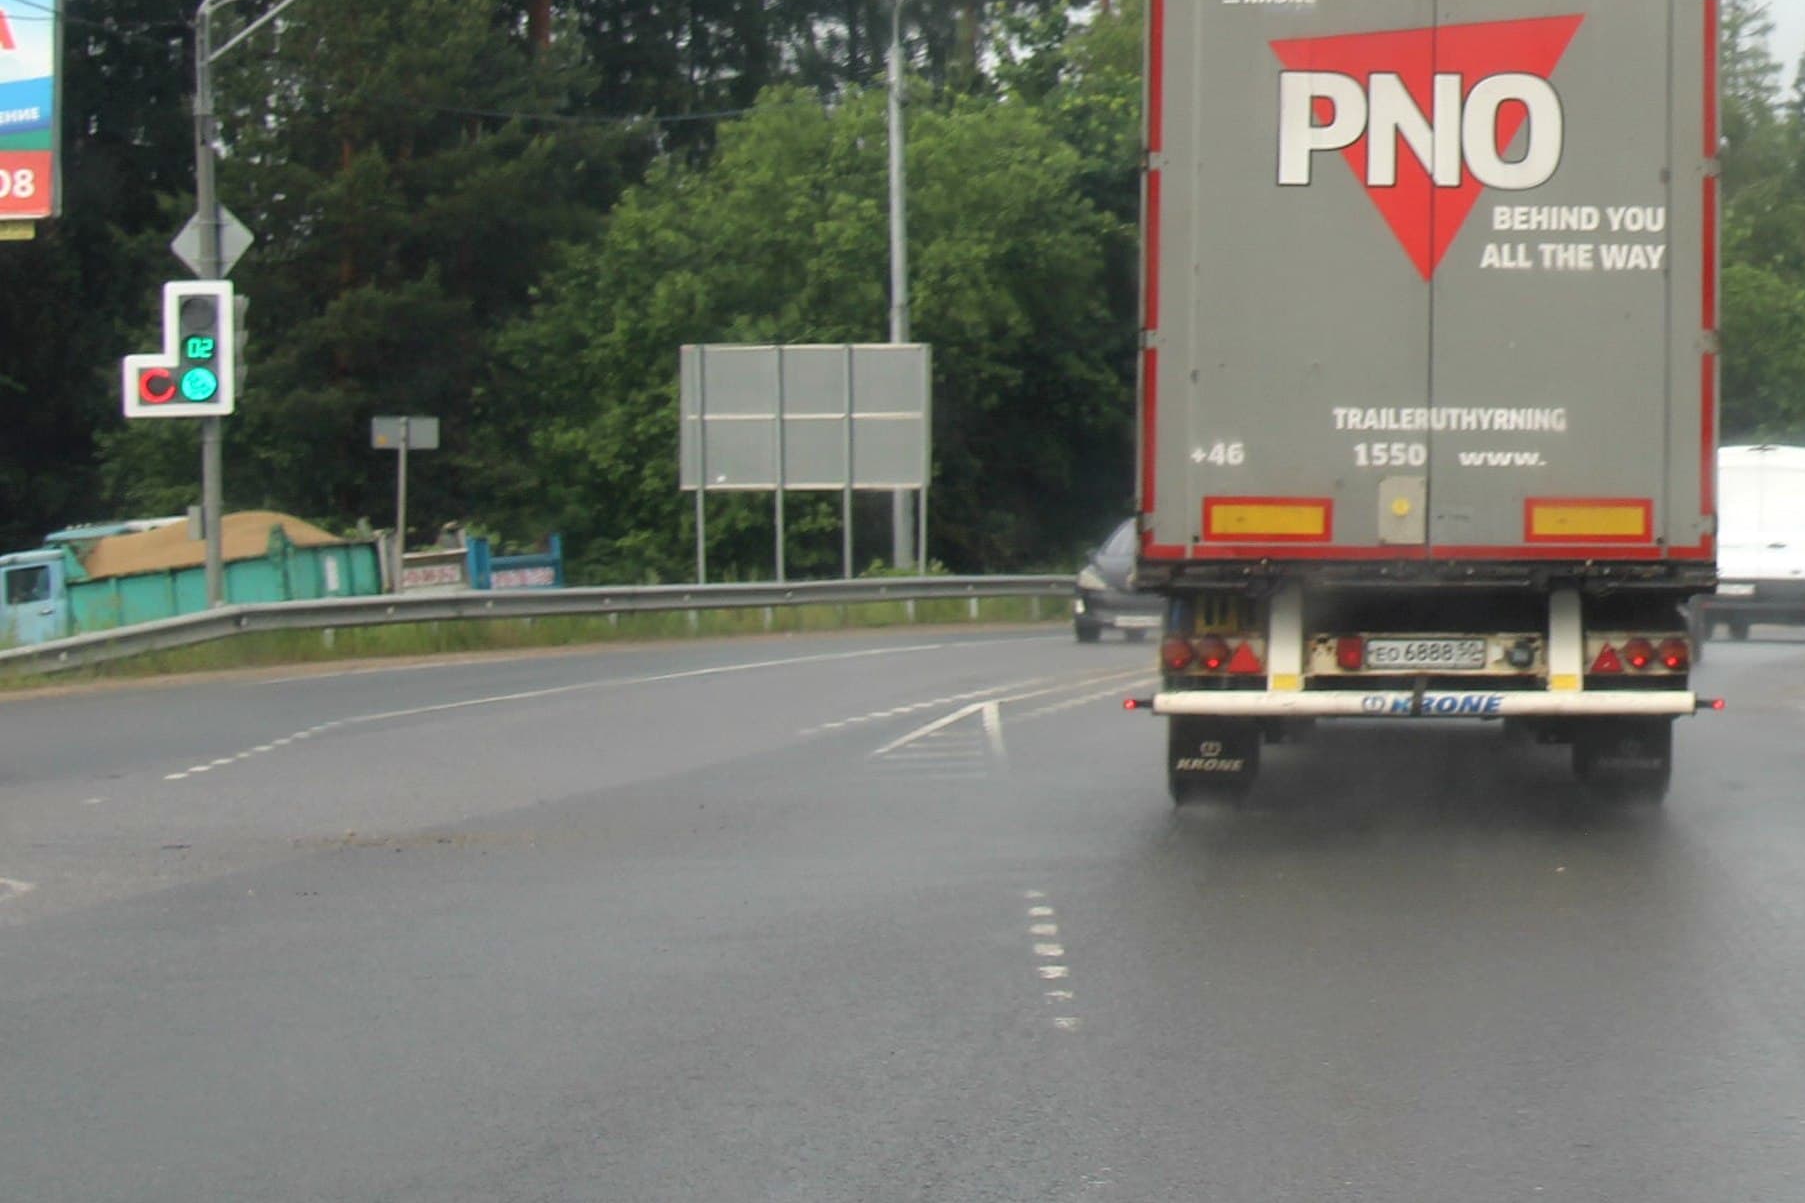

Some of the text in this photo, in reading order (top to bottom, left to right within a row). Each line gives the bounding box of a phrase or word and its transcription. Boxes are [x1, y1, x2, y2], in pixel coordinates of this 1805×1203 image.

[1276, 70, 1565, 191] PNO
[1493, 205, 1666, 232] BEHIND YOU
[1479, 242, 1667, 270] ALL THE WAY
[186, 337, 215, 358] 02
[1332, 407, 1567, 432] TRAILERUTHYRNING
[1190, 443, 1245, 466] +46
[1353, 442, 1428, 467] 1550
[1176, 757, 1245, 772] KRONE
